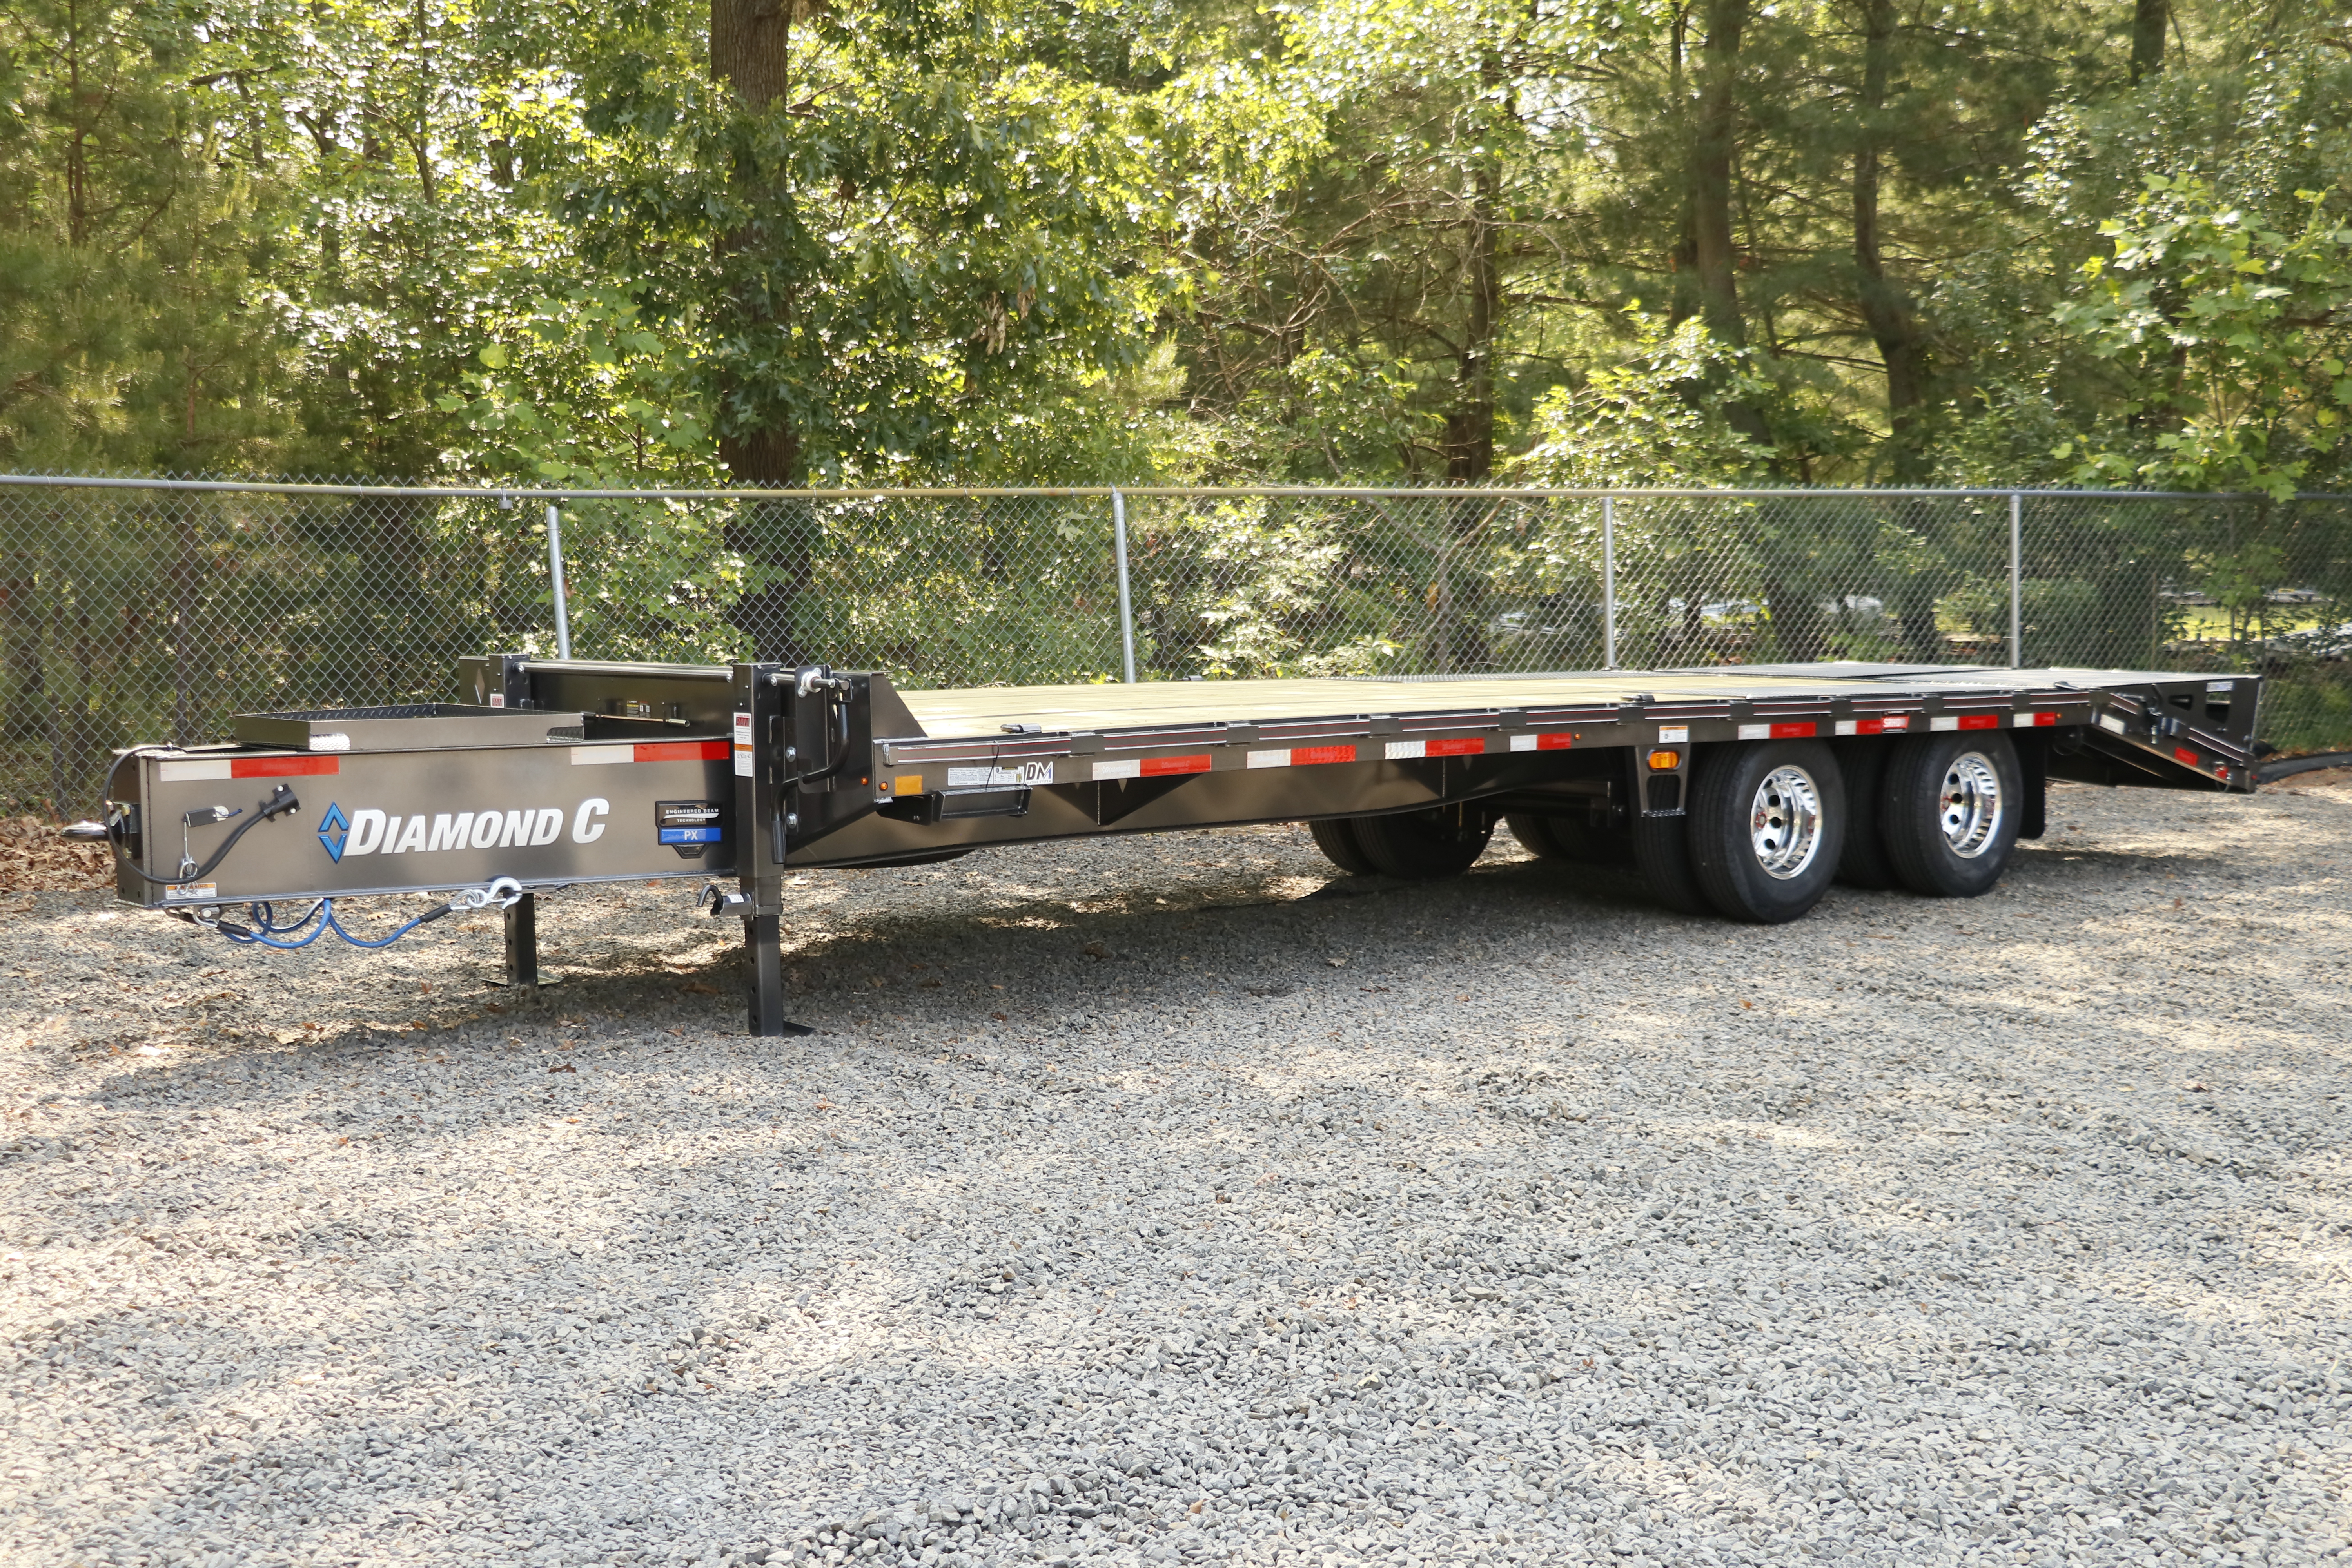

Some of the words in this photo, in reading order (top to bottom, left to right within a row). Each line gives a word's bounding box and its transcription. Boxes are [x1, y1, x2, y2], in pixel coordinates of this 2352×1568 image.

[736, 717, 750, 726] RAM
[343, 809, 564, 857] DIAMOND
[572, 798, 610, 844] C
[684, 830, 698, 840] PX
